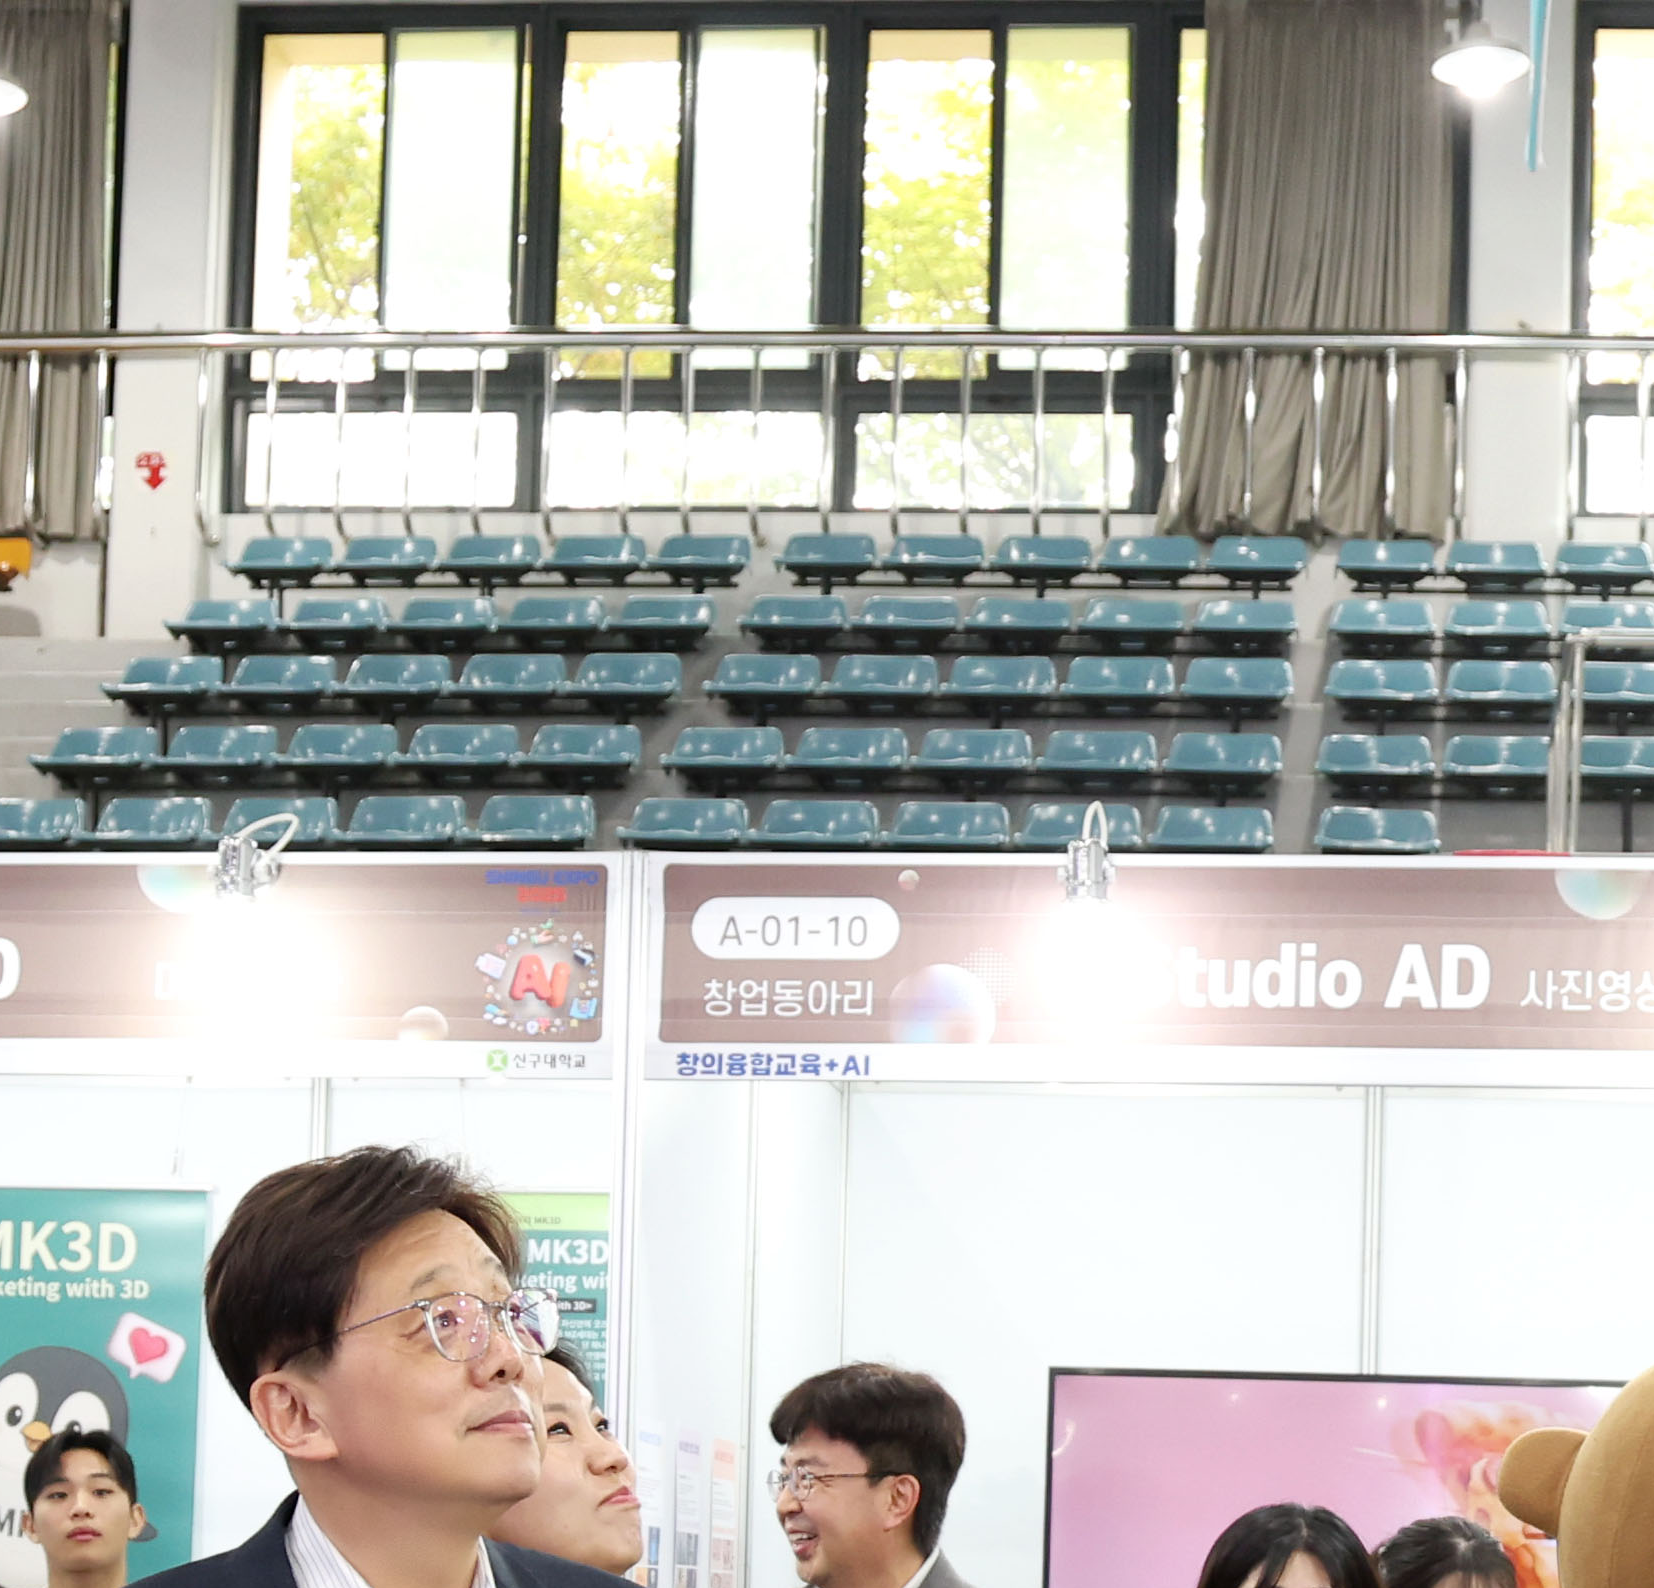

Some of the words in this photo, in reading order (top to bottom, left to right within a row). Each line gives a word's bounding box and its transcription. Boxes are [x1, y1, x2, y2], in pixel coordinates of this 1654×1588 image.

[718, 915, 868, 947] A-01-10
[509, 953, 573, 1009] AI
[1383, 942, 1491, 1011] AD
[703, 978, 874, 1017] 창업동아리
[512, 1053, 586, 1069] 신구대학교
[676, 1052, 870, 1077] 창의융합교육+AI
[526, 1238, 610, 1265] MK3D
[65, 1276, 116, 1299] with
[119, 1279, 151, 1299] 3D
[516, 1271, 578, 1294] keting
